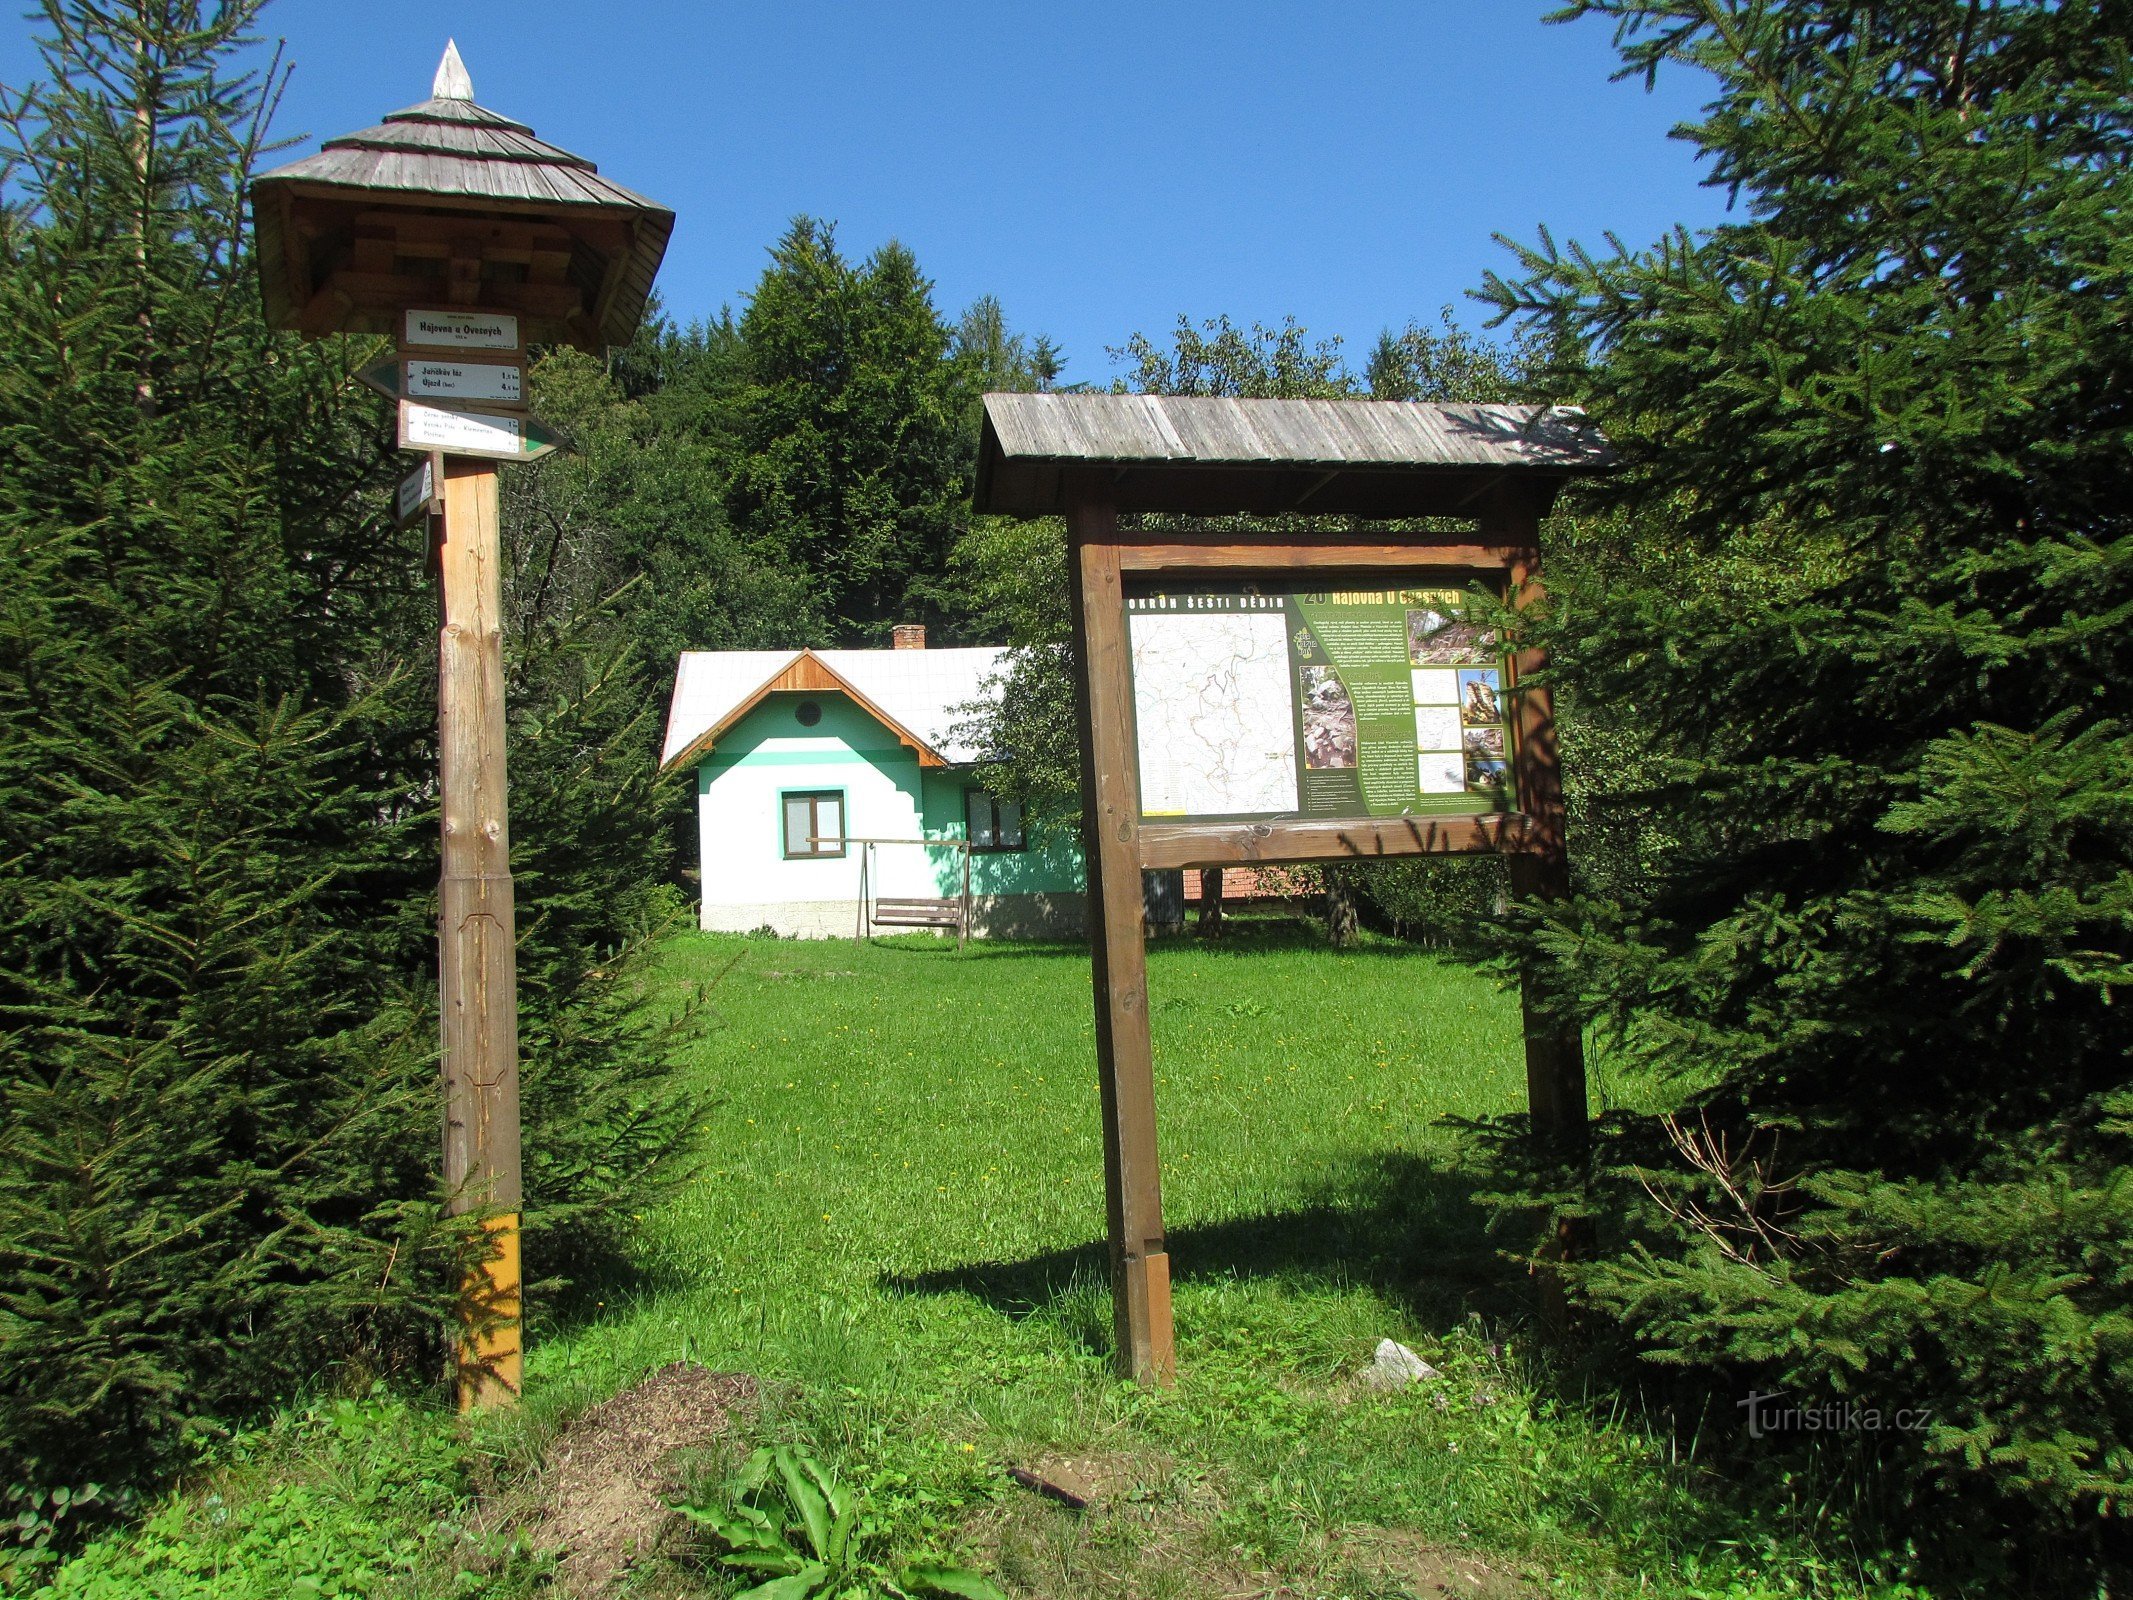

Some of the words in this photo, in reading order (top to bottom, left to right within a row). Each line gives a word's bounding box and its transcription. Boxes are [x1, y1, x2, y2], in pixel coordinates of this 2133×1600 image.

[1128, 598, 1177, 609] OKRUH
[1187, 596, 1230, 608] ŠESTI
[1240, 596, 1284, 608] DĚDIN
[1387, 591, 1395, 604] U
